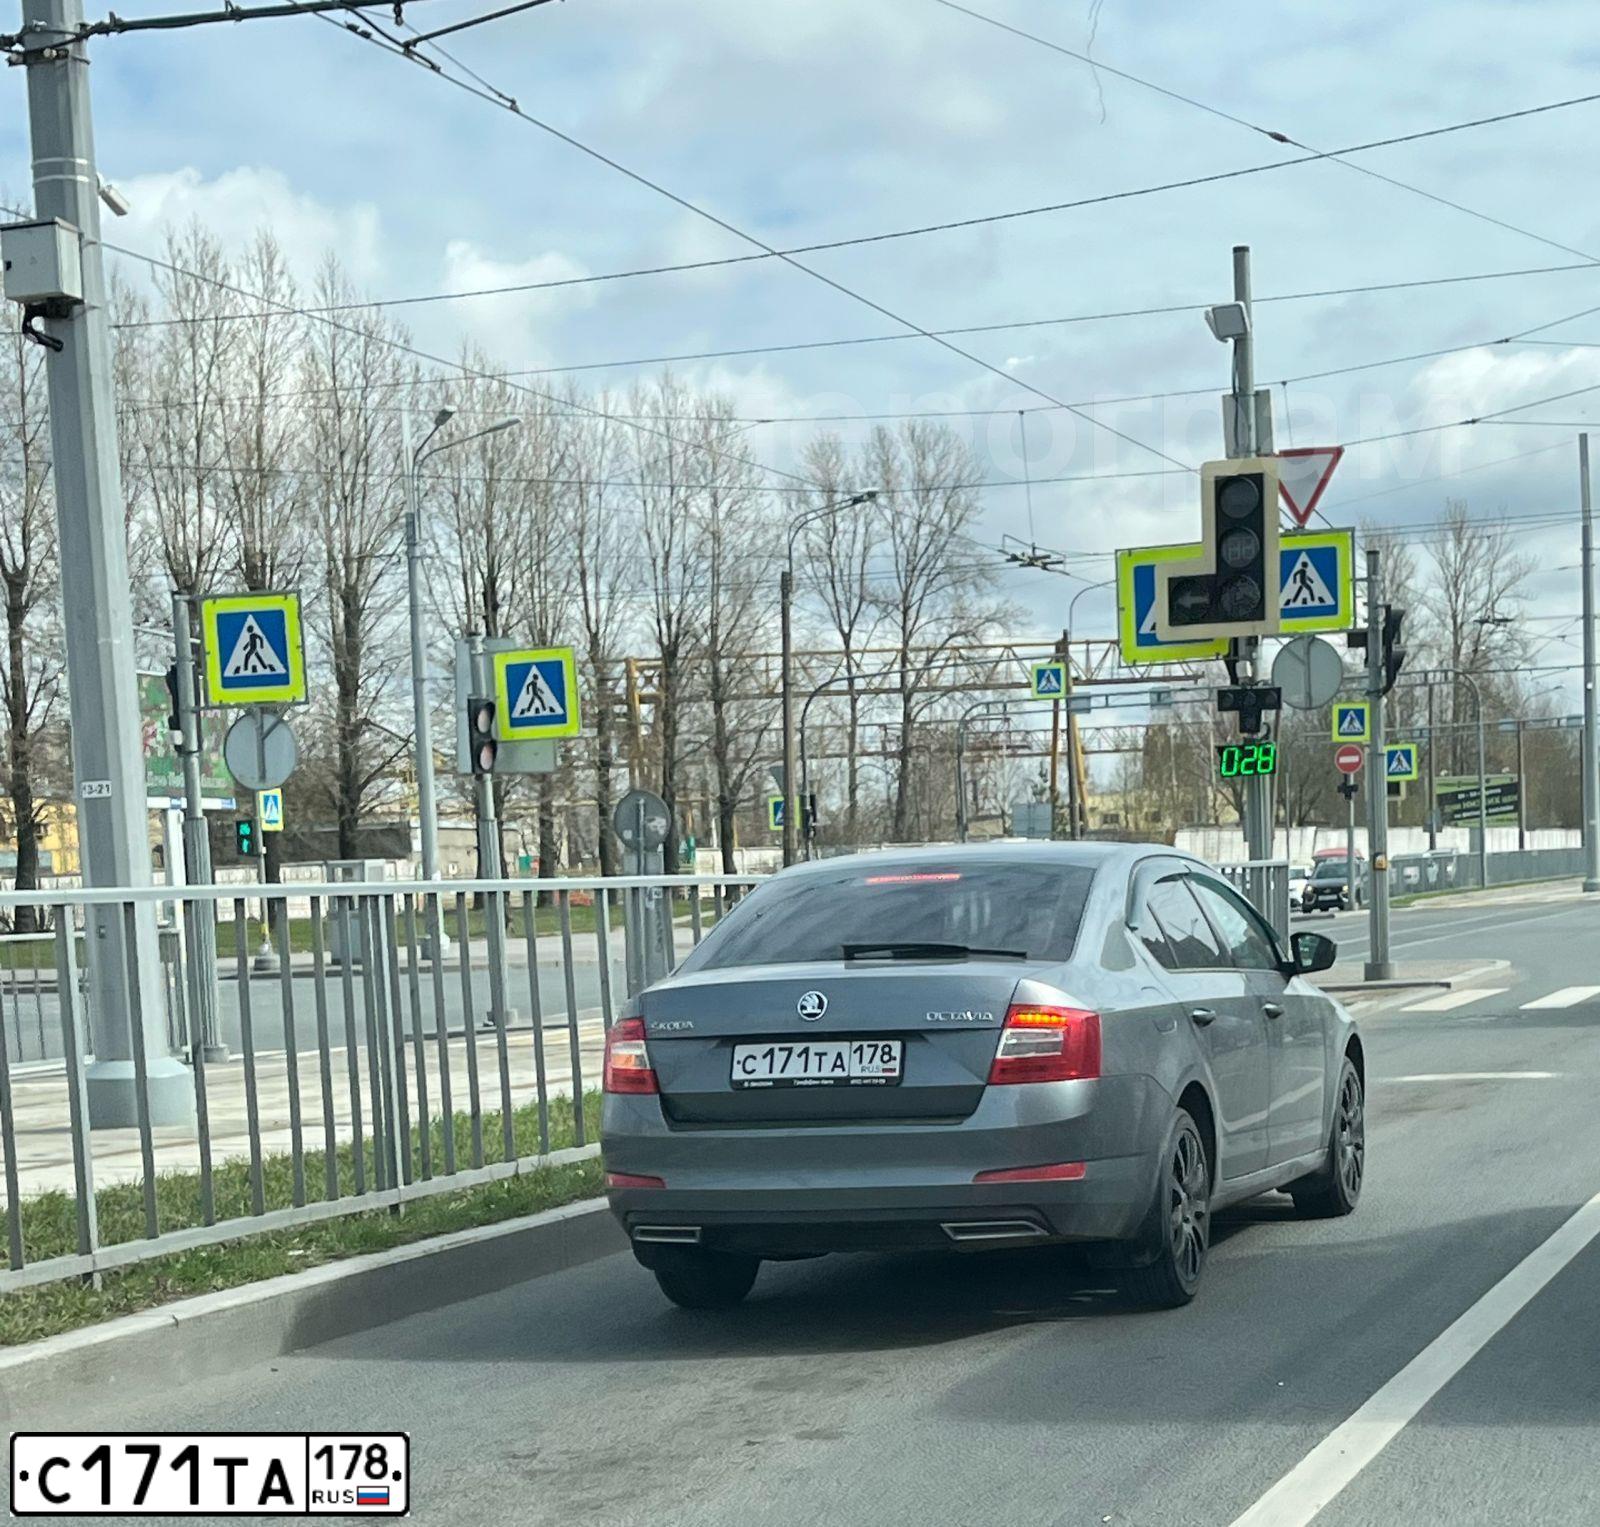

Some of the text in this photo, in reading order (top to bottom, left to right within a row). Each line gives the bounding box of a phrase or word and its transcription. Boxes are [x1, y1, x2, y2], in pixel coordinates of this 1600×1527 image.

[1221, 742, 1276, 776] 028
[926, 1010, 994, 1021] OCTAVIA
[742, 1043, 893, 1075] С171ТА 178
[860, 1066, 881, 1074] RUS
